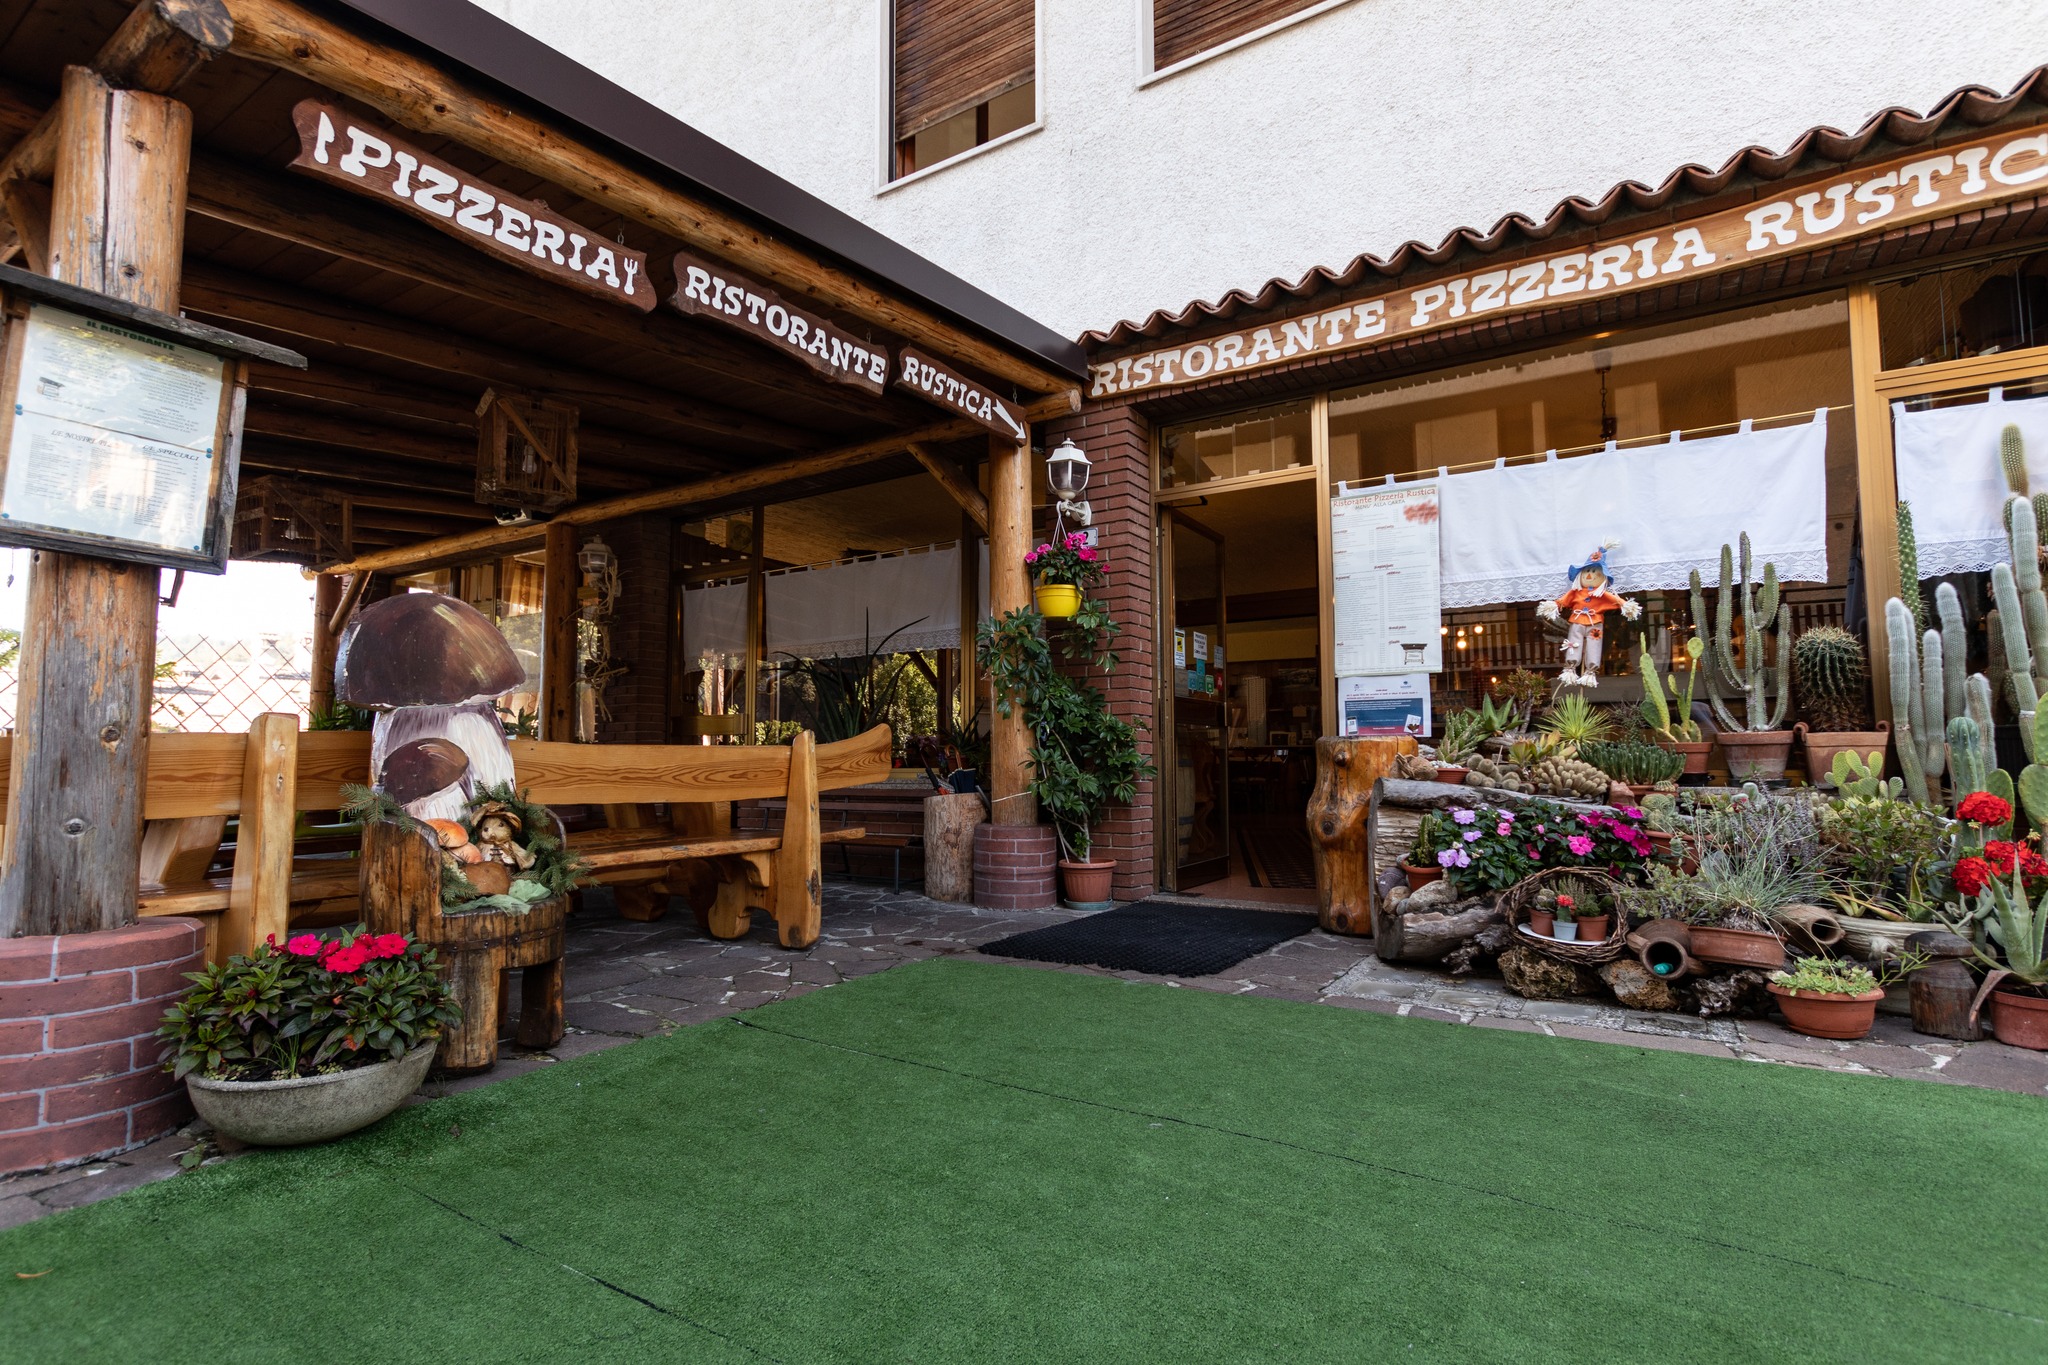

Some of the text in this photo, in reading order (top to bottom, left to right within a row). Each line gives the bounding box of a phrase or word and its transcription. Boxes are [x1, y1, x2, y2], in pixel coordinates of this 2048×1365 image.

[339, 125, 621, 289] PIZZERIA
[86, 320, 175, 351] IL RISTORANTE
[684, 265, 886, 385] RISTORANTE
[1091, 299, 1387, 397] RISTORANTE
[1409, 227, 1718, 327] PIZZERIA
[902, 356, 992, 421] RUSTICA
[1333, 488, 1436, 507] Ristorante Pizzeria Rustica
